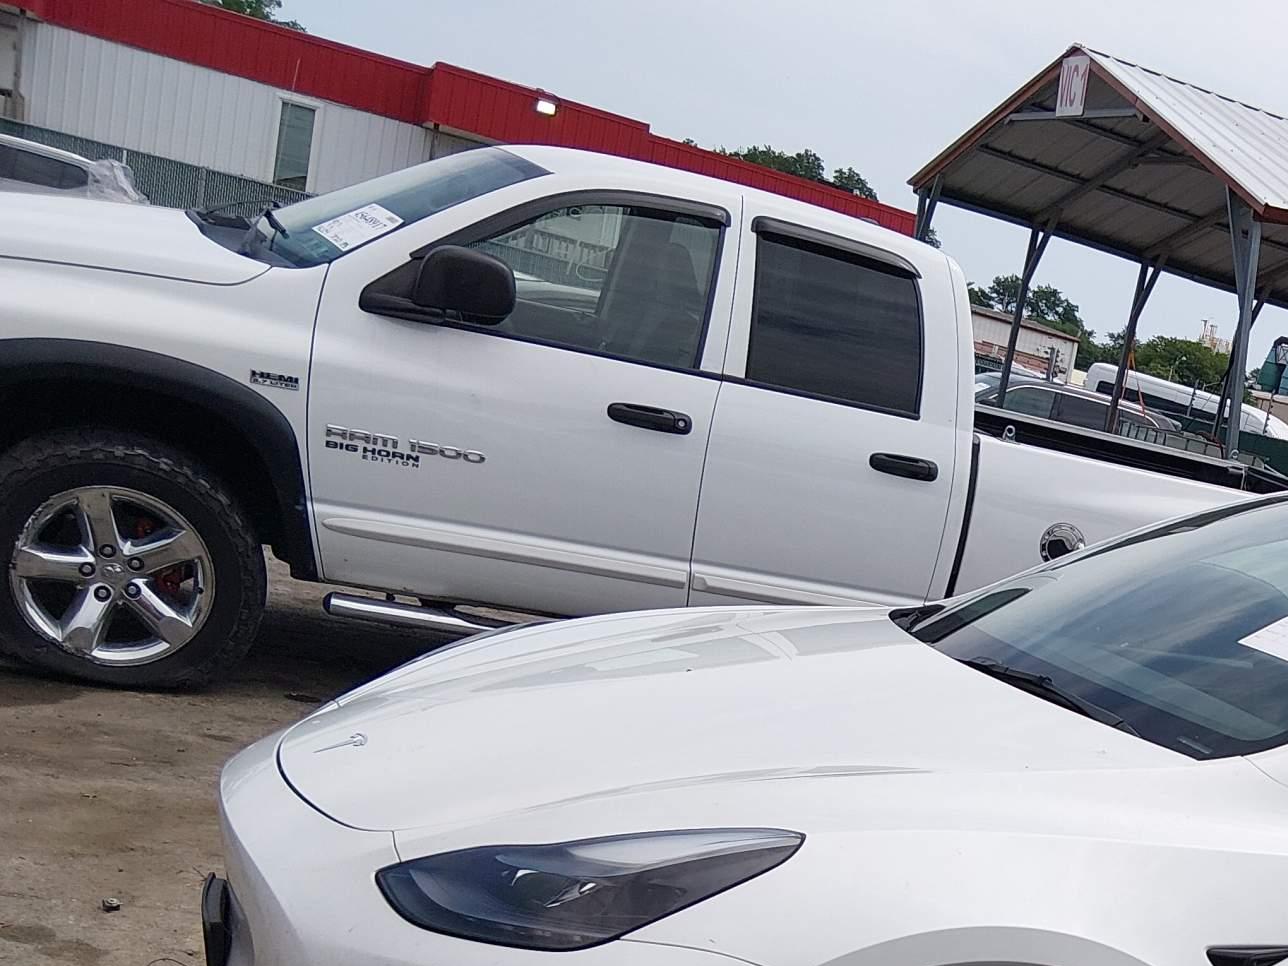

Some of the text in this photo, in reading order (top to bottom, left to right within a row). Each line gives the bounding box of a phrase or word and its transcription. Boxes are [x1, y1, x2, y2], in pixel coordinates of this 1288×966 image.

[250, 369, 299, 385] HEMI
[325, 423, 486, 464] RAM 1500
[325, 440, 420, 463] BIG HORN
[362, 455, 420, 469] EDITION
